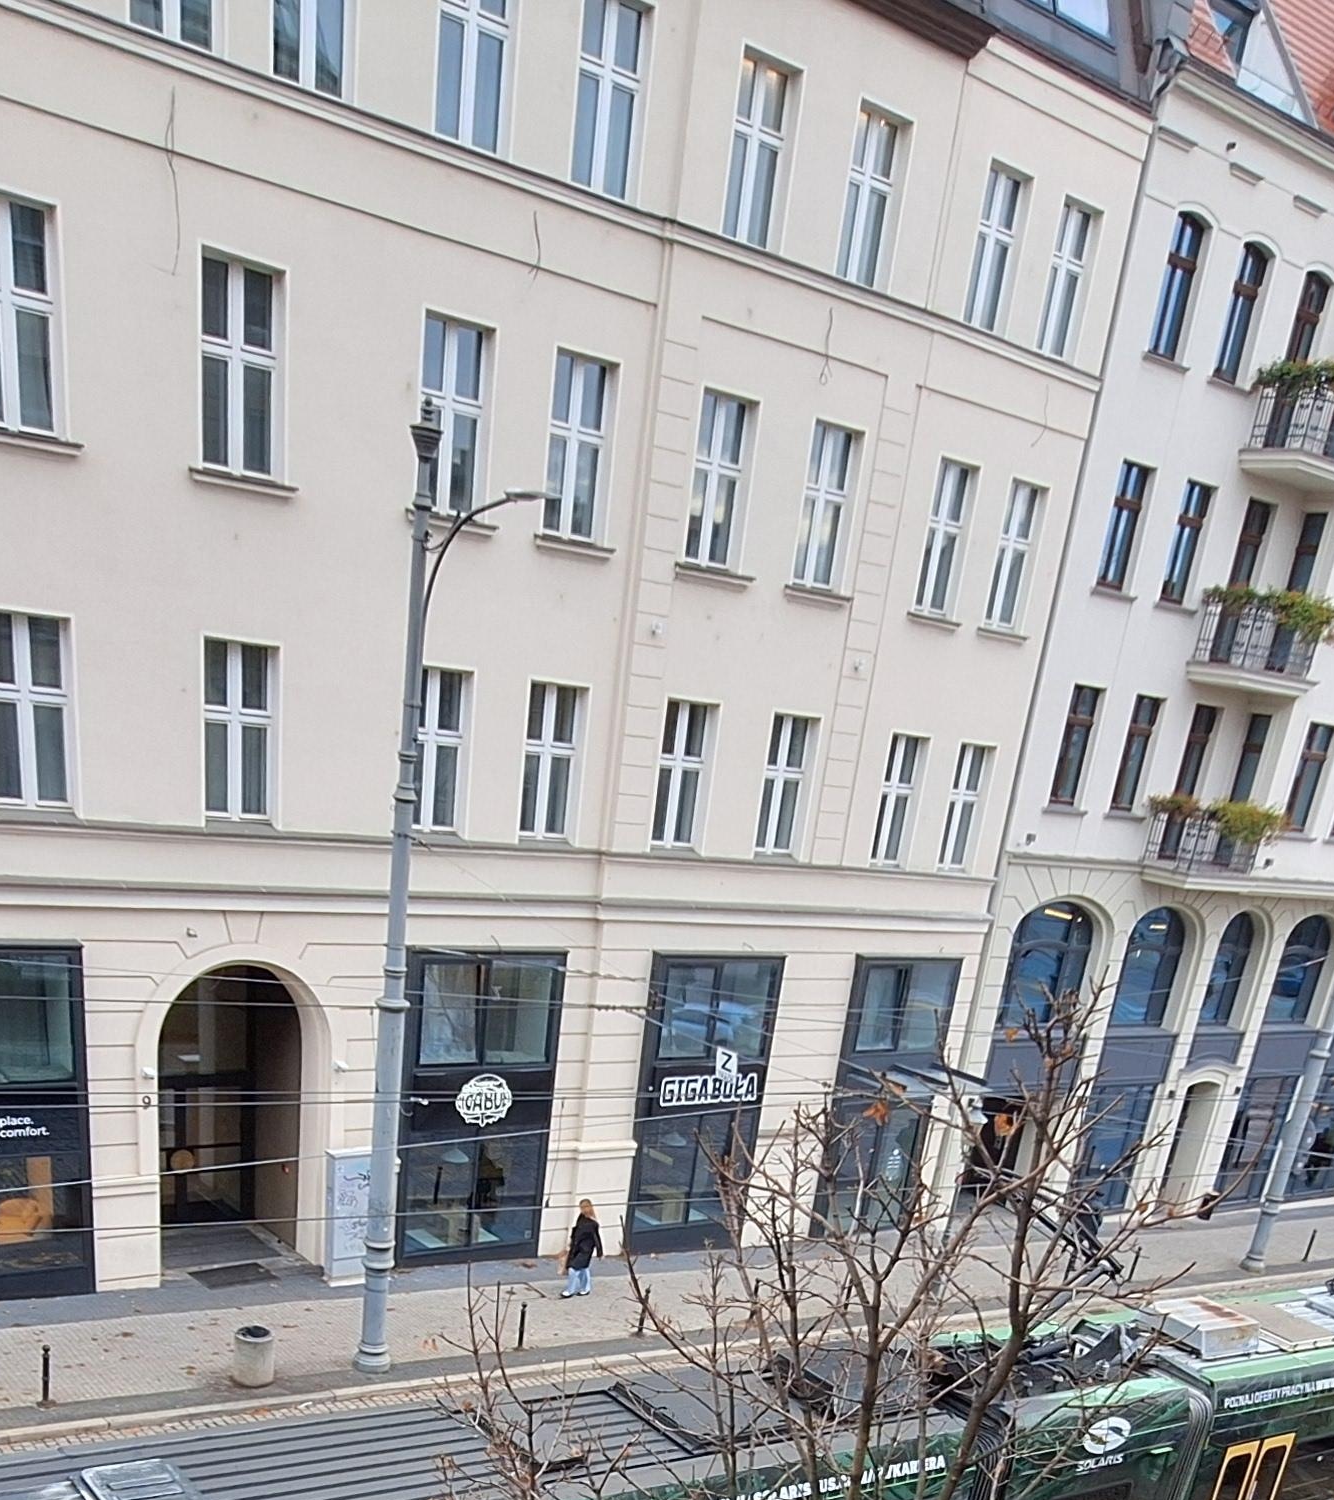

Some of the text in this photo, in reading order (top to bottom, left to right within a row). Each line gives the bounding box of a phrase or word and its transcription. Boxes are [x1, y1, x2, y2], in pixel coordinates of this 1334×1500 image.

[661, 1074, 757, 1107] GIGABUŁA
[142, 1095, 152, 1110] 9
[0, 1115, 34, 1128] place.
[0, 1126, 50, 1139] comfort.
[1075, 1452, 1124, 1472] SOLARIS
